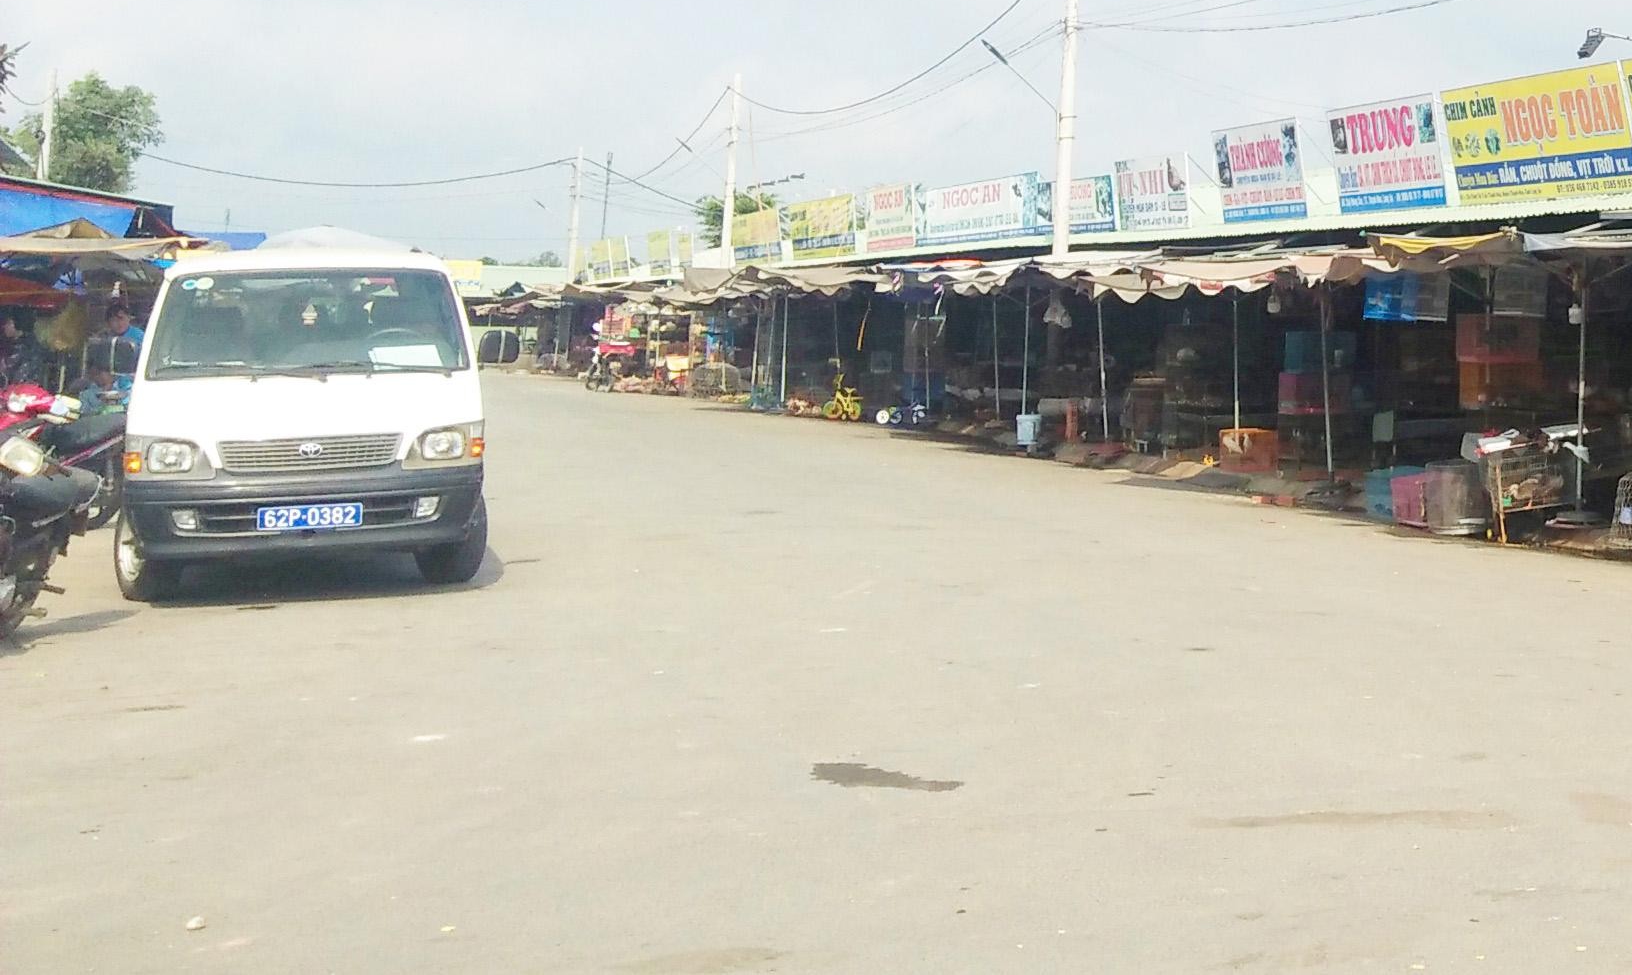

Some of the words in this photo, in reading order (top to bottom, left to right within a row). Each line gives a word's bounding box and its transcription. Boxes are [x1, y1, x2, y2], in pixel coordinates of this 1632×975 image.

[1444, 101, 1468, 121] CHIM
[1469, 91, 1497, 118] CẢNH
[1346, 106, 1416, 155] TRUNG
[1500, 94, 1558, 154] NGỌC
[1576, 159, 1592, 179] VỊT
[264, 506, 356, 527] 62P-0382
